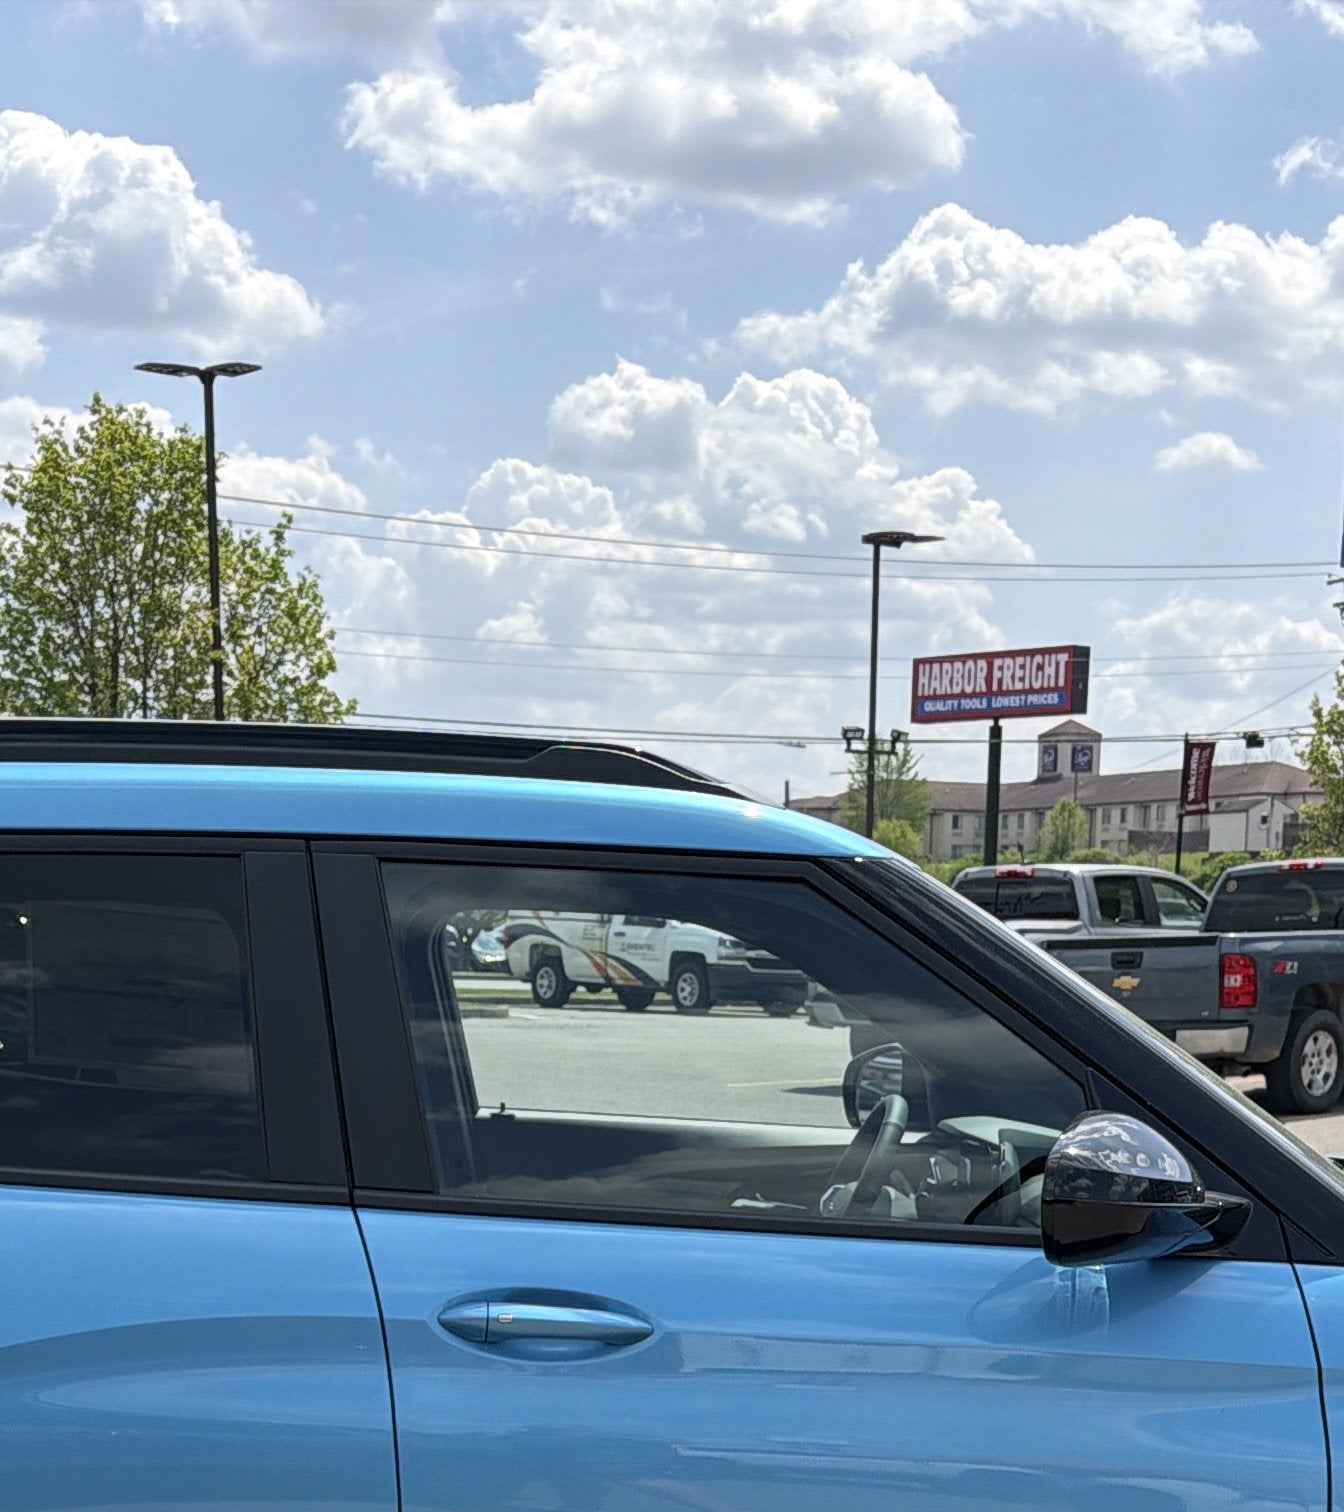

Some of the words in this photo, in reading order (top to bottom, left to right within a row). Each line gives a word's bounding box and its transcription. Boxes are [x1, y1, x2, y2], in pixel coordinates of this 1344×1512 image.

[917, 659, 989, 697] HARBOR
[992, 653, 1069, 692] FREIGHT
[924, 699, 958, 712] QUALITY
[961, 698, 988, 710] TOOLS
[992, 695, 1026, 708] LOWEST
[1027, 692, 1059, 706] PRICES
